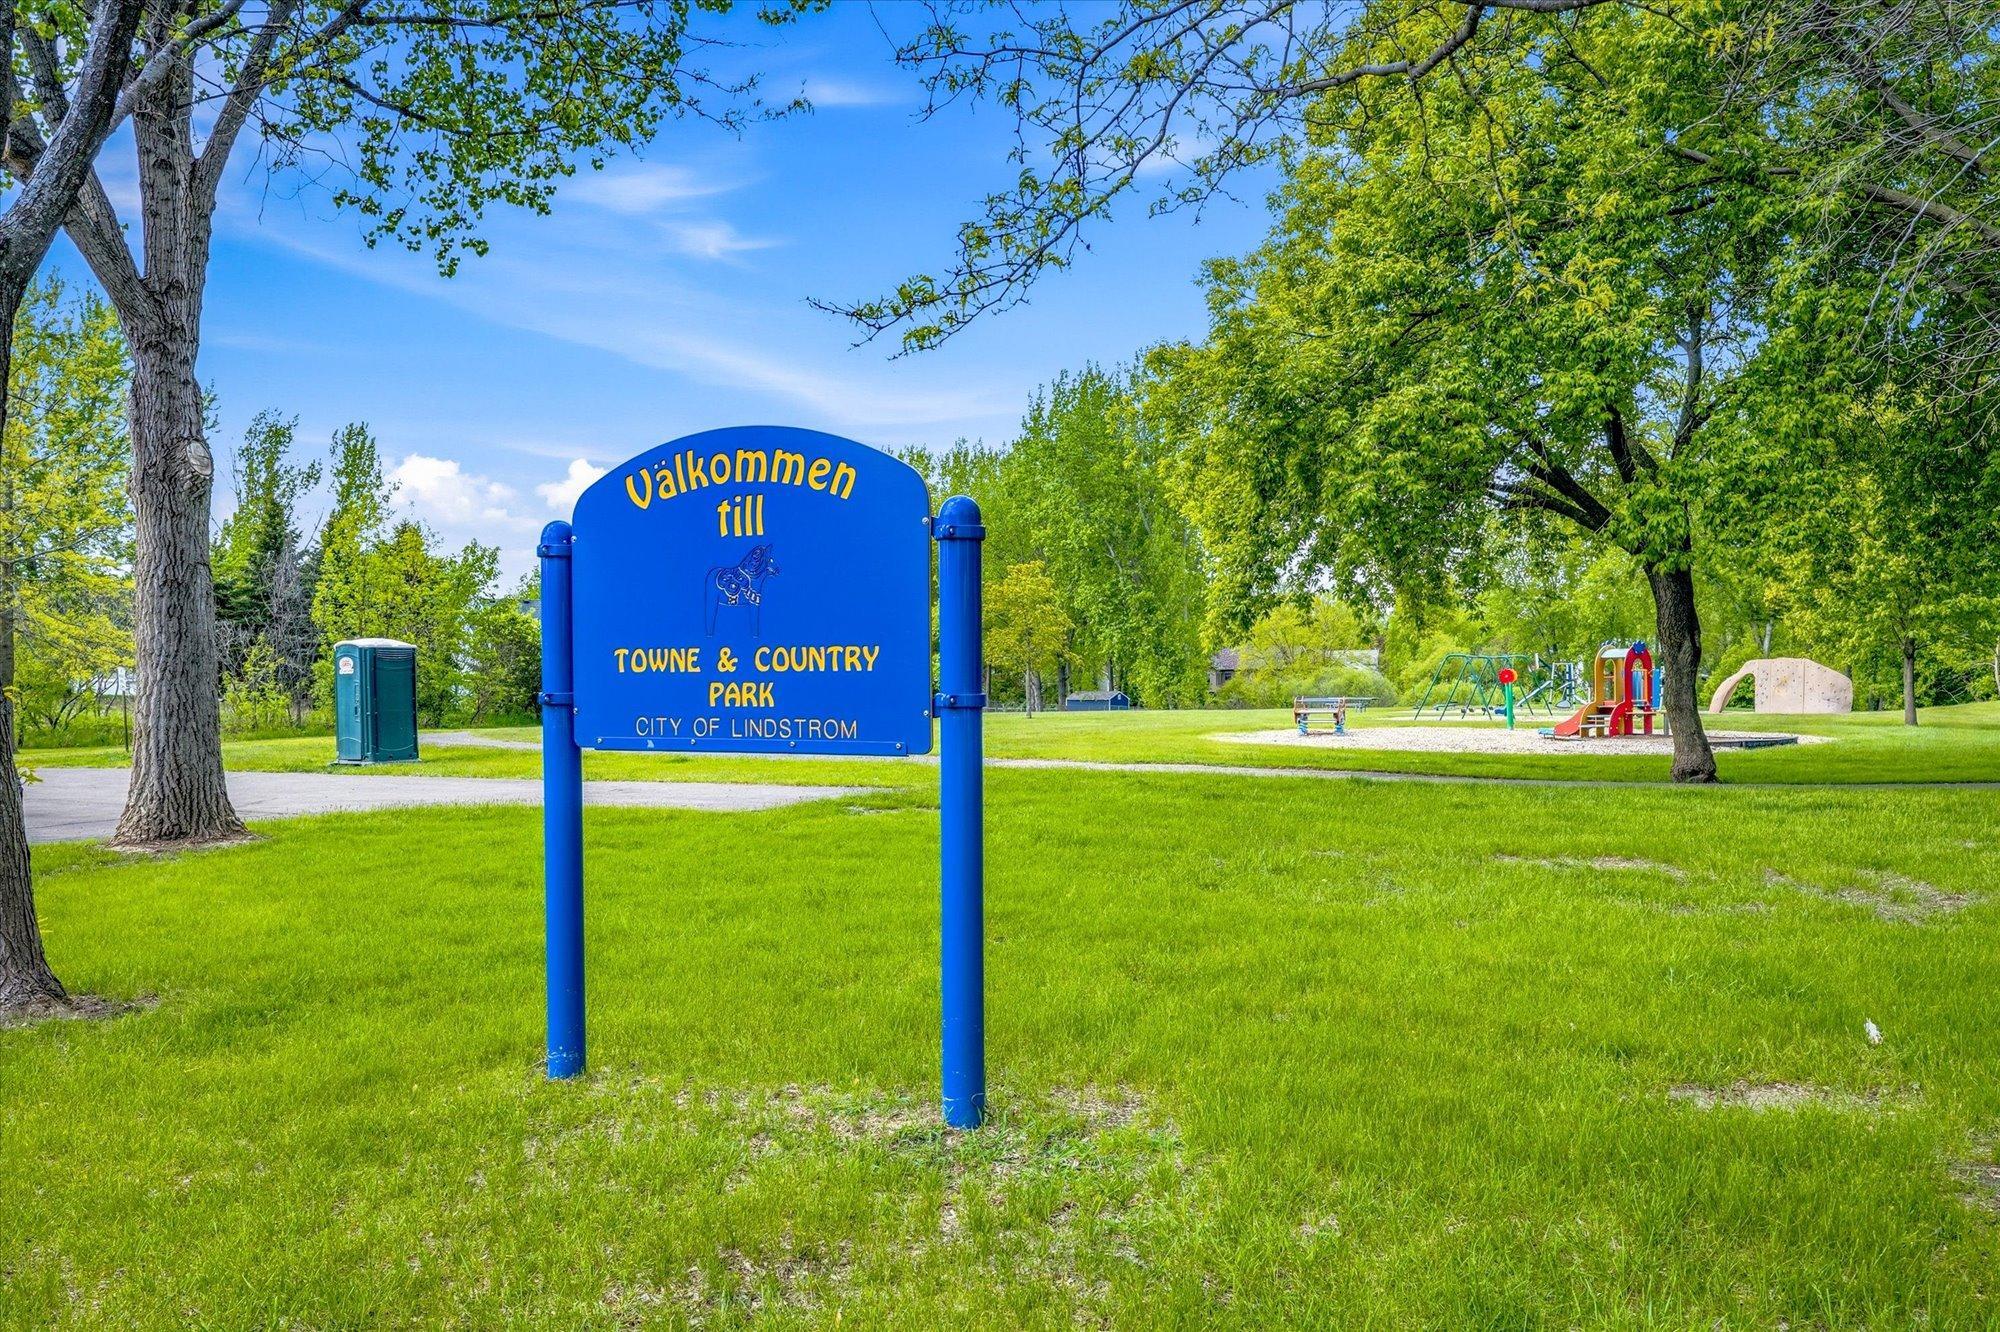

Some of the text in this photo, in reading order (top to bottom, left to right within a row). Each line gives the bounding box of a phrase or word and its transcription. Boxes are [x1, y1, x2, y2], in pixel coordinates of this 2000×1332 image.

[625, 448, 856, 510] Välkommen
[716, 494, 764, 537] till
[614, 645, 879, 673] TOWNE & COUNTRY
[709, 681, 774, 707] PARK
[636, 717, 857, 739] CITY OF LINDSTROM
